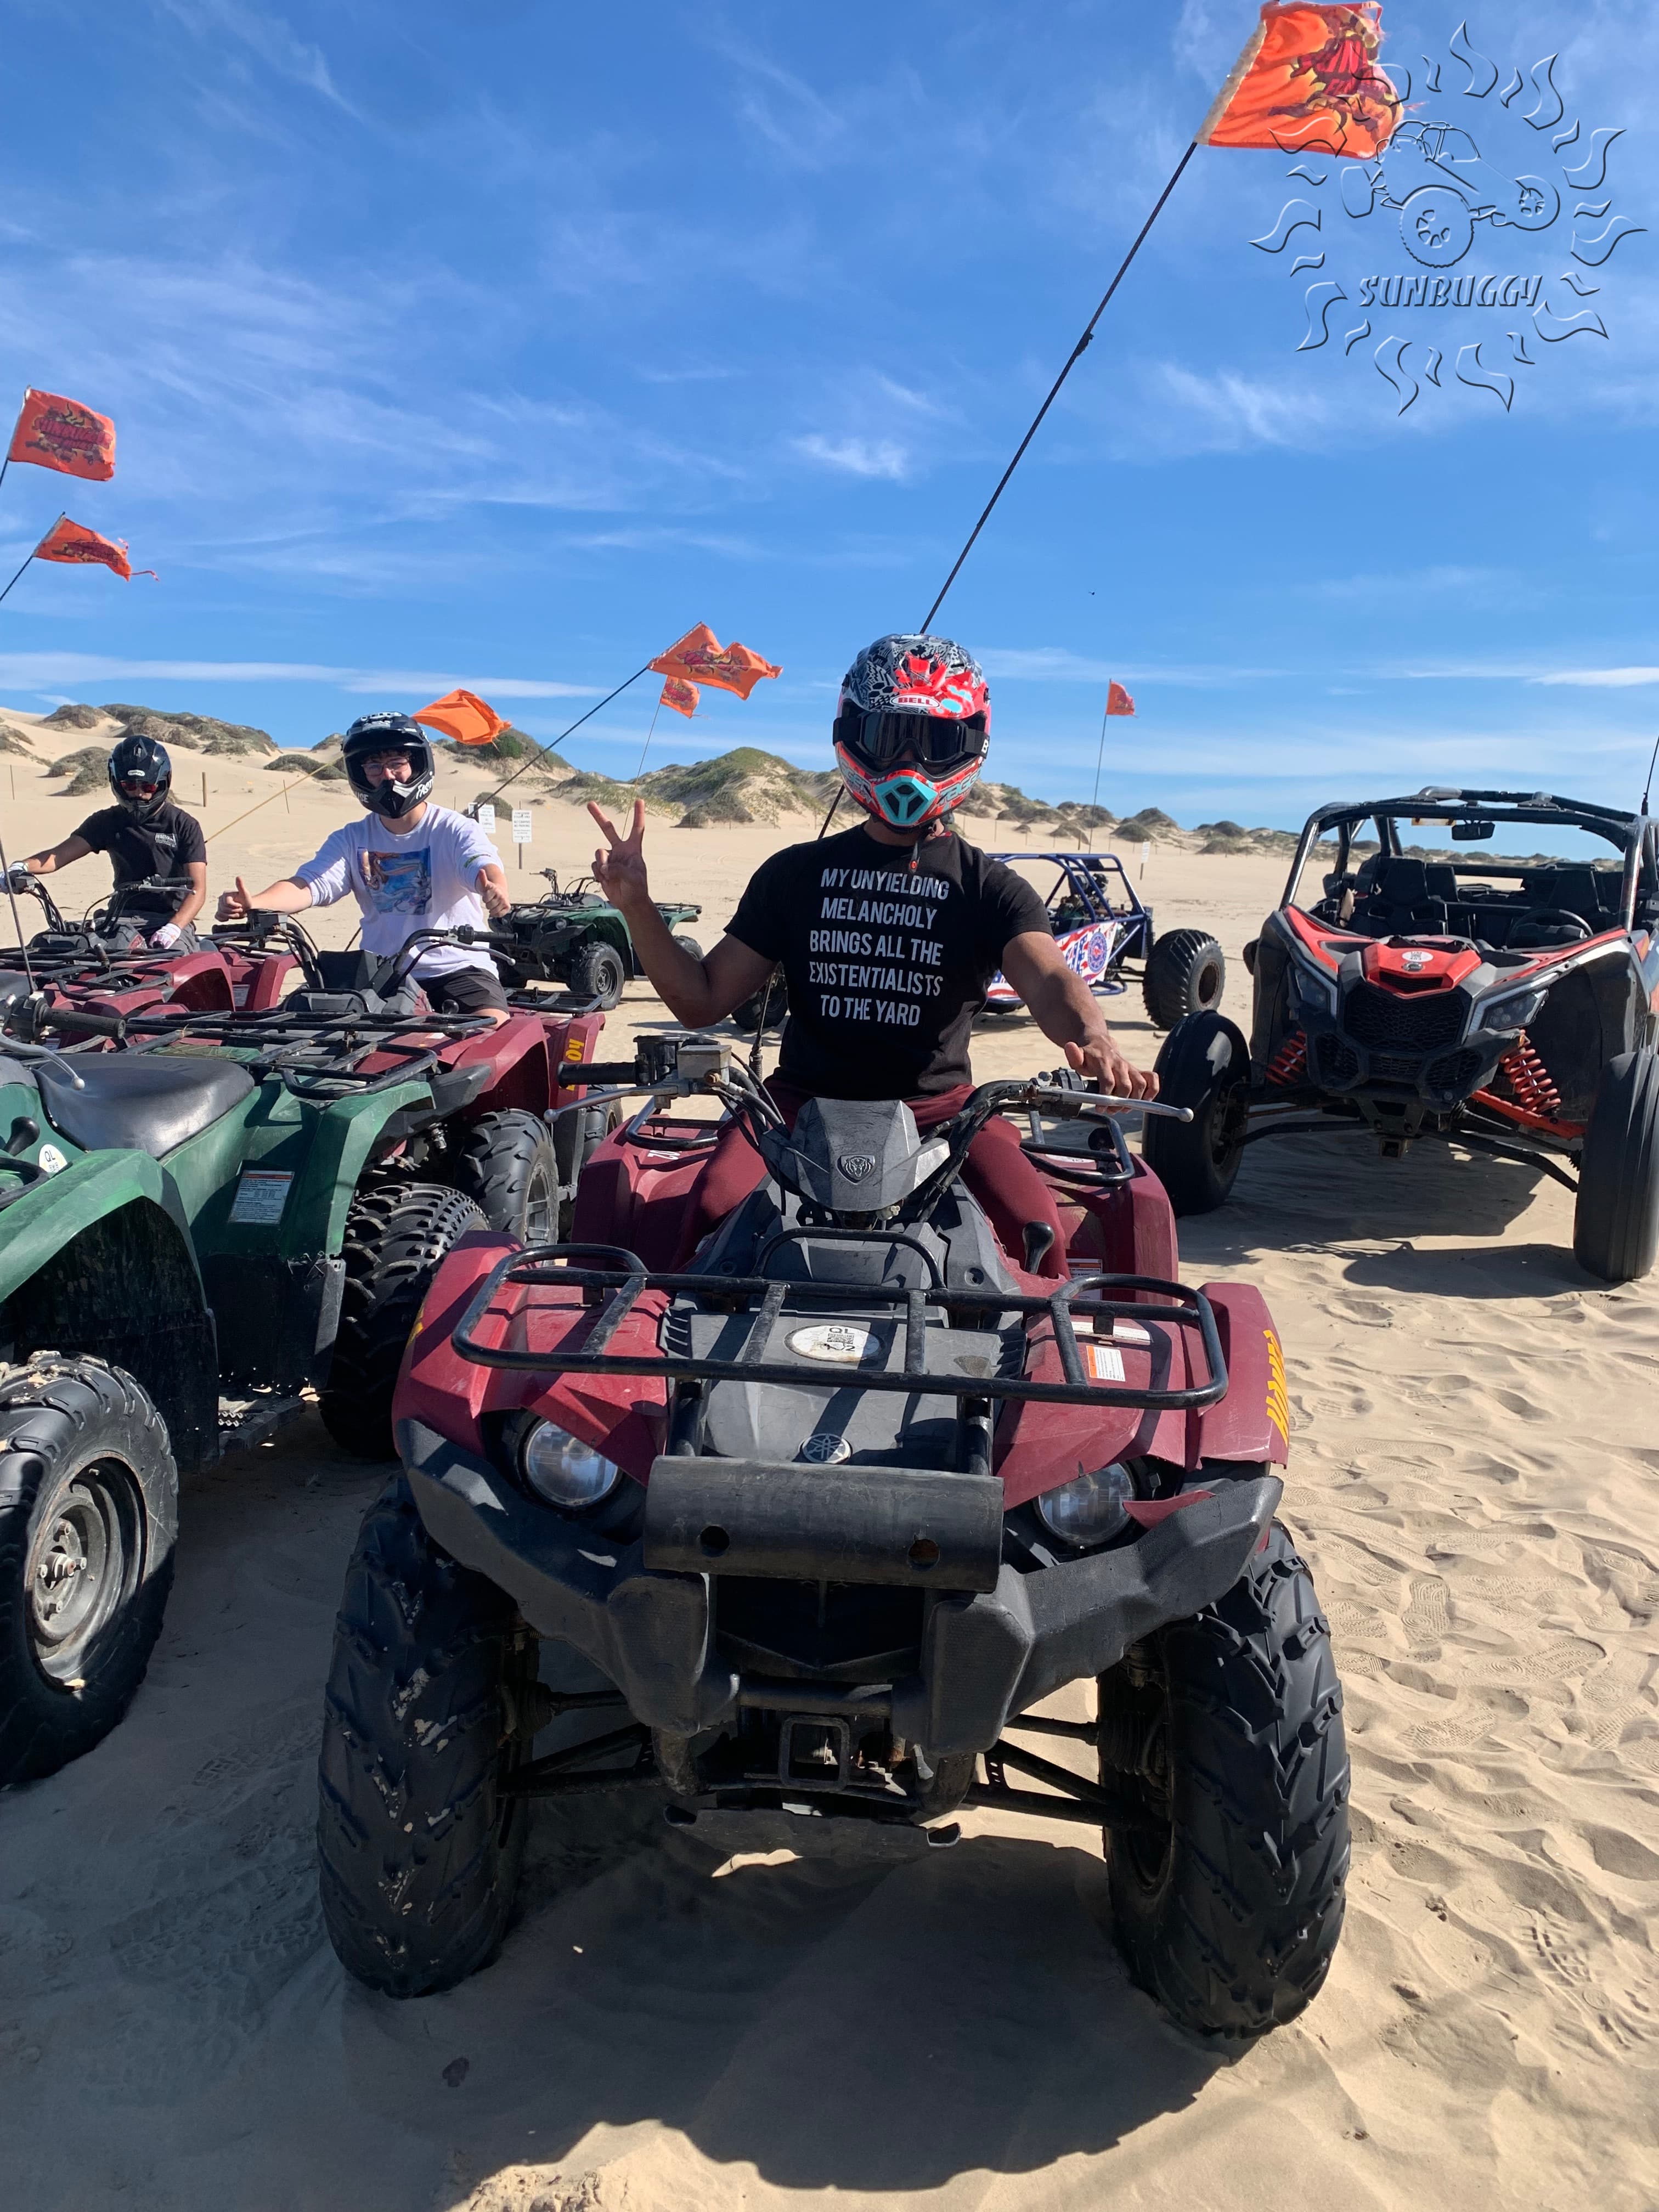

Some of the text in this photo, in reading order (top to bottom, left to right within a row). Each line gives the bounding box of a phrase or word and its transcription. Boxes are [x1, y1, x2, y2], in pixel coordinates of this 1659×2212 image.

[898, 697, 933, 706] BELL
[821, 868, 950, 900] MY UNYIELDING
[821, 898, 937, 930] MELANCHOLY
[810, 930, 943, 966] BRINGS ALL THE
[809, 962, 943, 996] EXISTENTIALISTS
[821, 995, 921, 1026] TO THE YARD
[44, 1149, 56, 1163] QL
